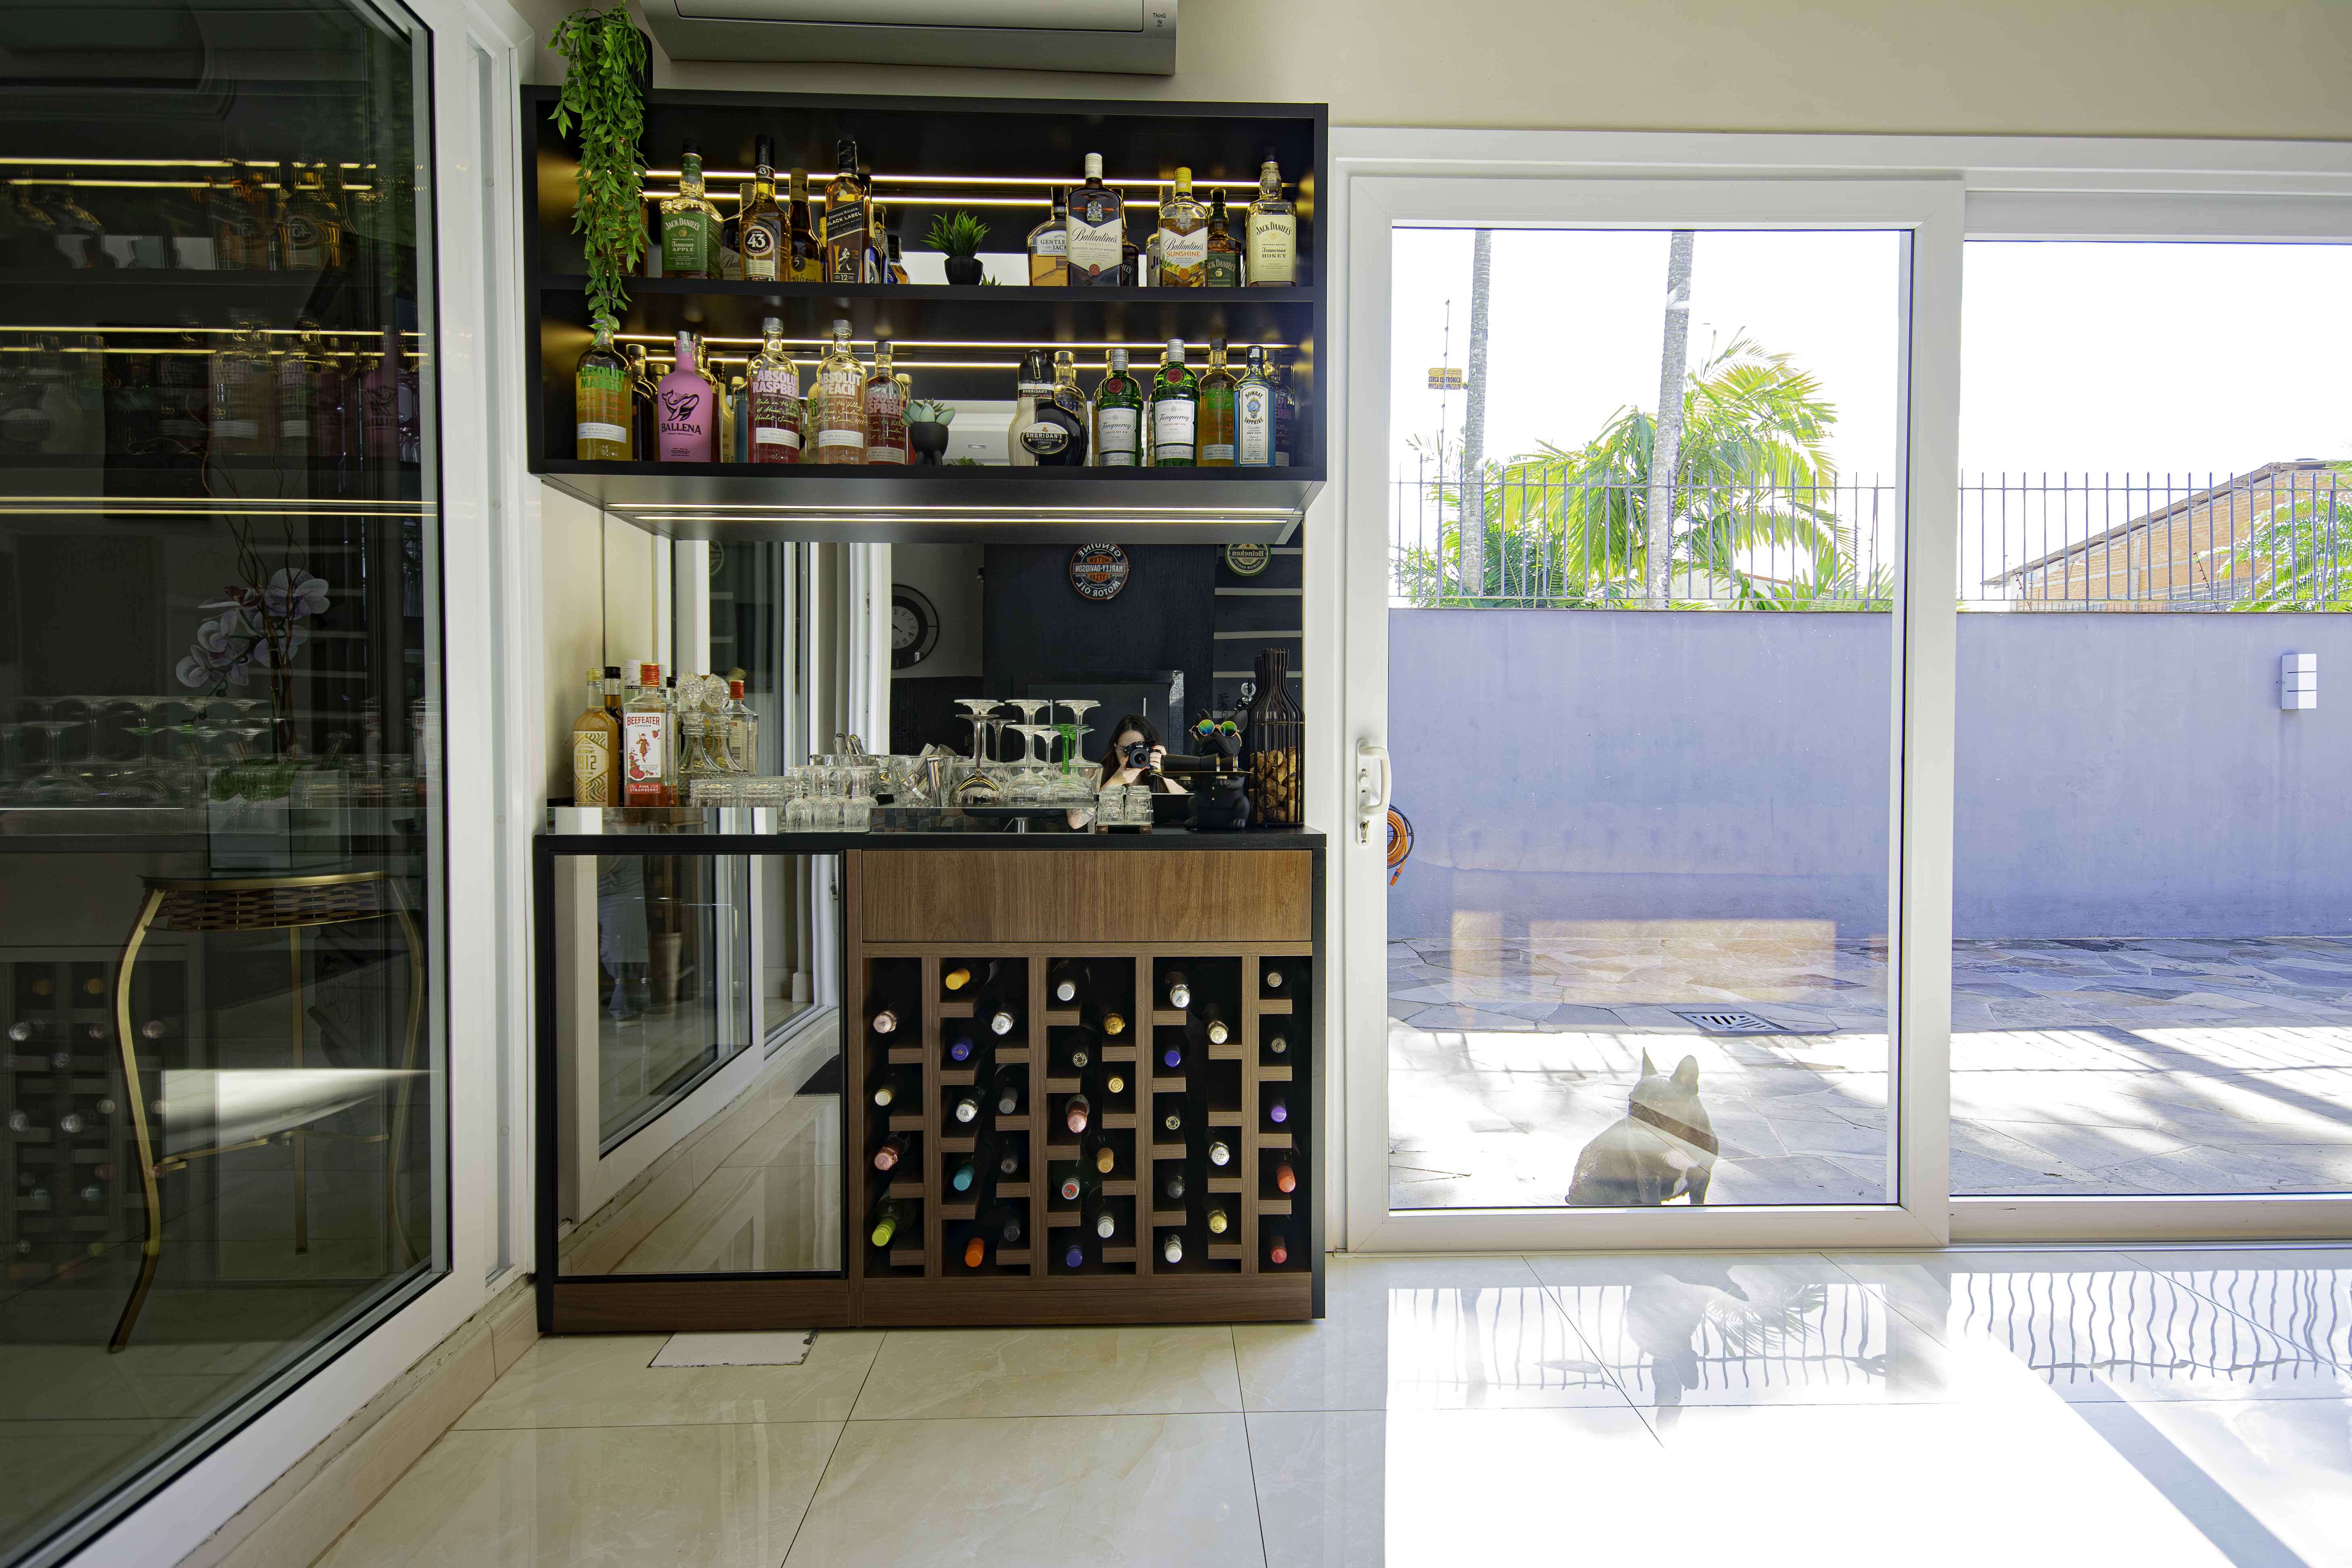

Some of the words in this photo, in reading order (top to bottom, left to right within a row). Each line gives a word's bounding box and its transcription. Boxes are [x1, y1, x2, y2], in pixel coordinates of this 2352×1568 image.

[827, 217, 843, 227] BLACK
[844, 211, 862, 220] LABEL
[828, 212, 844, 221] JOHNNIE
[665, 220, 678, 230] JACK
[679, 218, 700, 231] DANIEL'S
[1256, 224, 1269, 235] JACK
[1270, 222, 1292, 235] DANIEL'S
[747, 234, 766, 248] 43
[1071, 227, 1118, 243] Ballantine's
[1163, 238, 1204, 251] Ballantine's
[794, 256, 799, 267] 5
[1216, 259, 1236, 272] DANIEL'S
[579, 366, 627, 382] ABSOLUT
[819, 372, 862, 386] ABSOLUT
[581, 377, 623, 392] MANGO
[823, 383, 855, 396] PEACH
[868, 392, 902, 406] BSOLUT
[1245, 391, 1263, 399] BOMBAY
[778, 416, 795, 424] Since
[1159, 414, 1190, 422] Tanqueray
[1244, 416, 1264, 424] SAPPHIRE
[661, 423, 702, 435] BALLENA
[1102, 422, 1131, 430] Tanqueray
[627, 717, 660, 726] BEEFEATER
[577, 755, 596, 770] 1912
